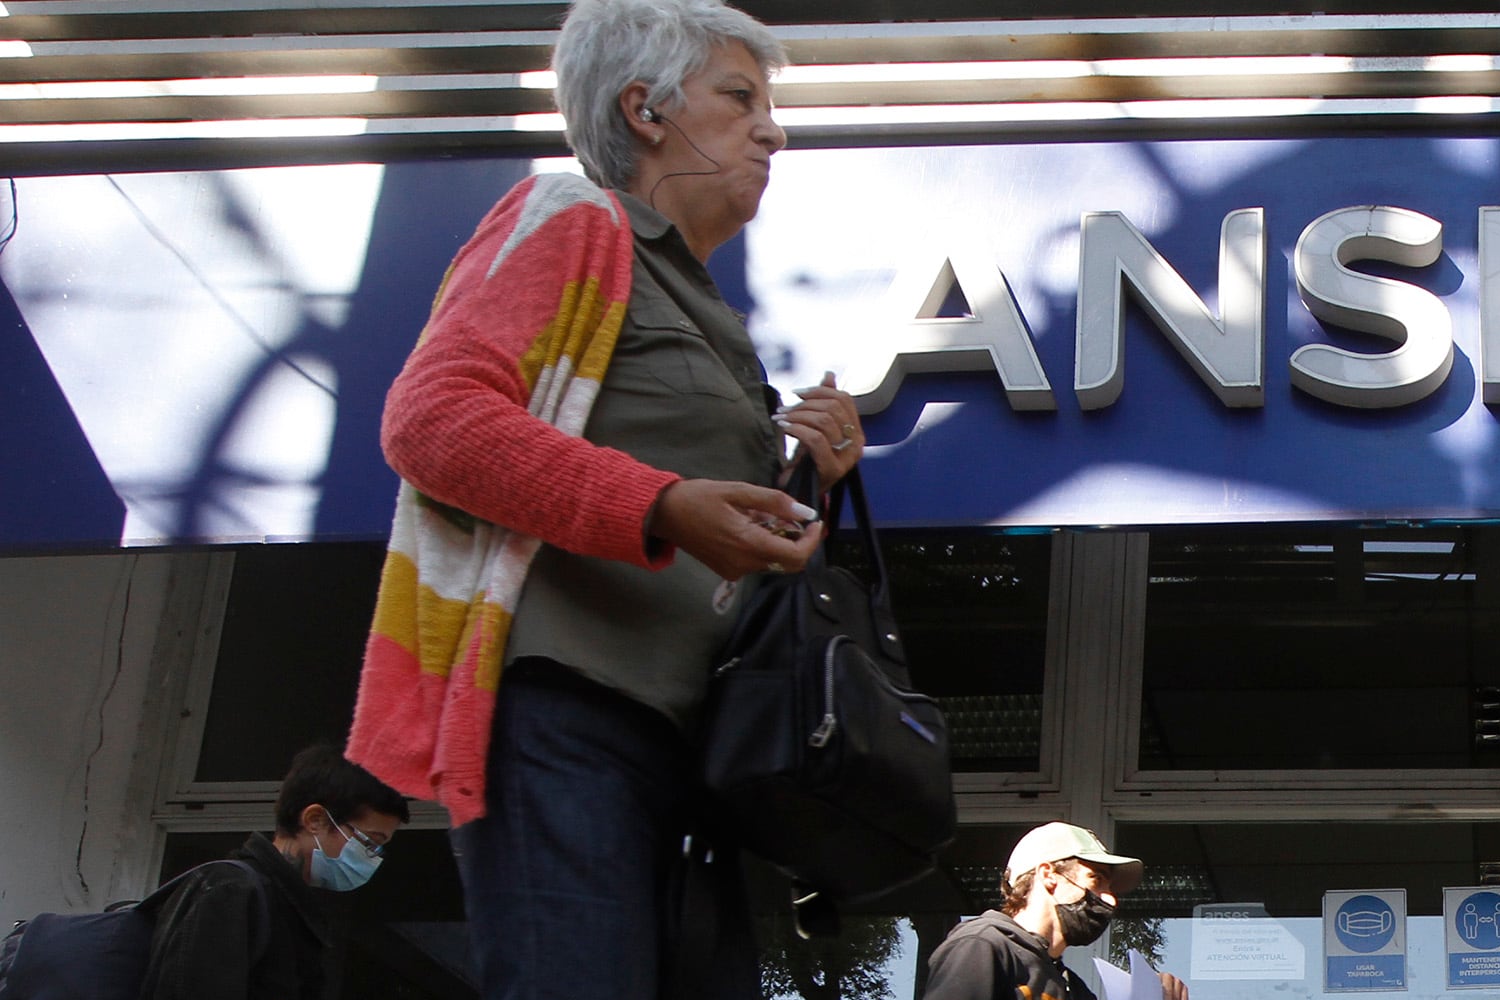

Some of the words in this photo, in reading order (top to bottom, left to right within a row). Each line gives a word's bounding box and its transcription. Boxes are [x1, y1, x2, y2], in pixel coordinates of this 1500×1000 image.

[1204, 911, 1250, 922] anses
[1207, 952, 1249, 961] ATENCIÓN
[1251, 952, 1287, 961] VIRTUAL
[1461, 956, 1500, 964] MANTENER
